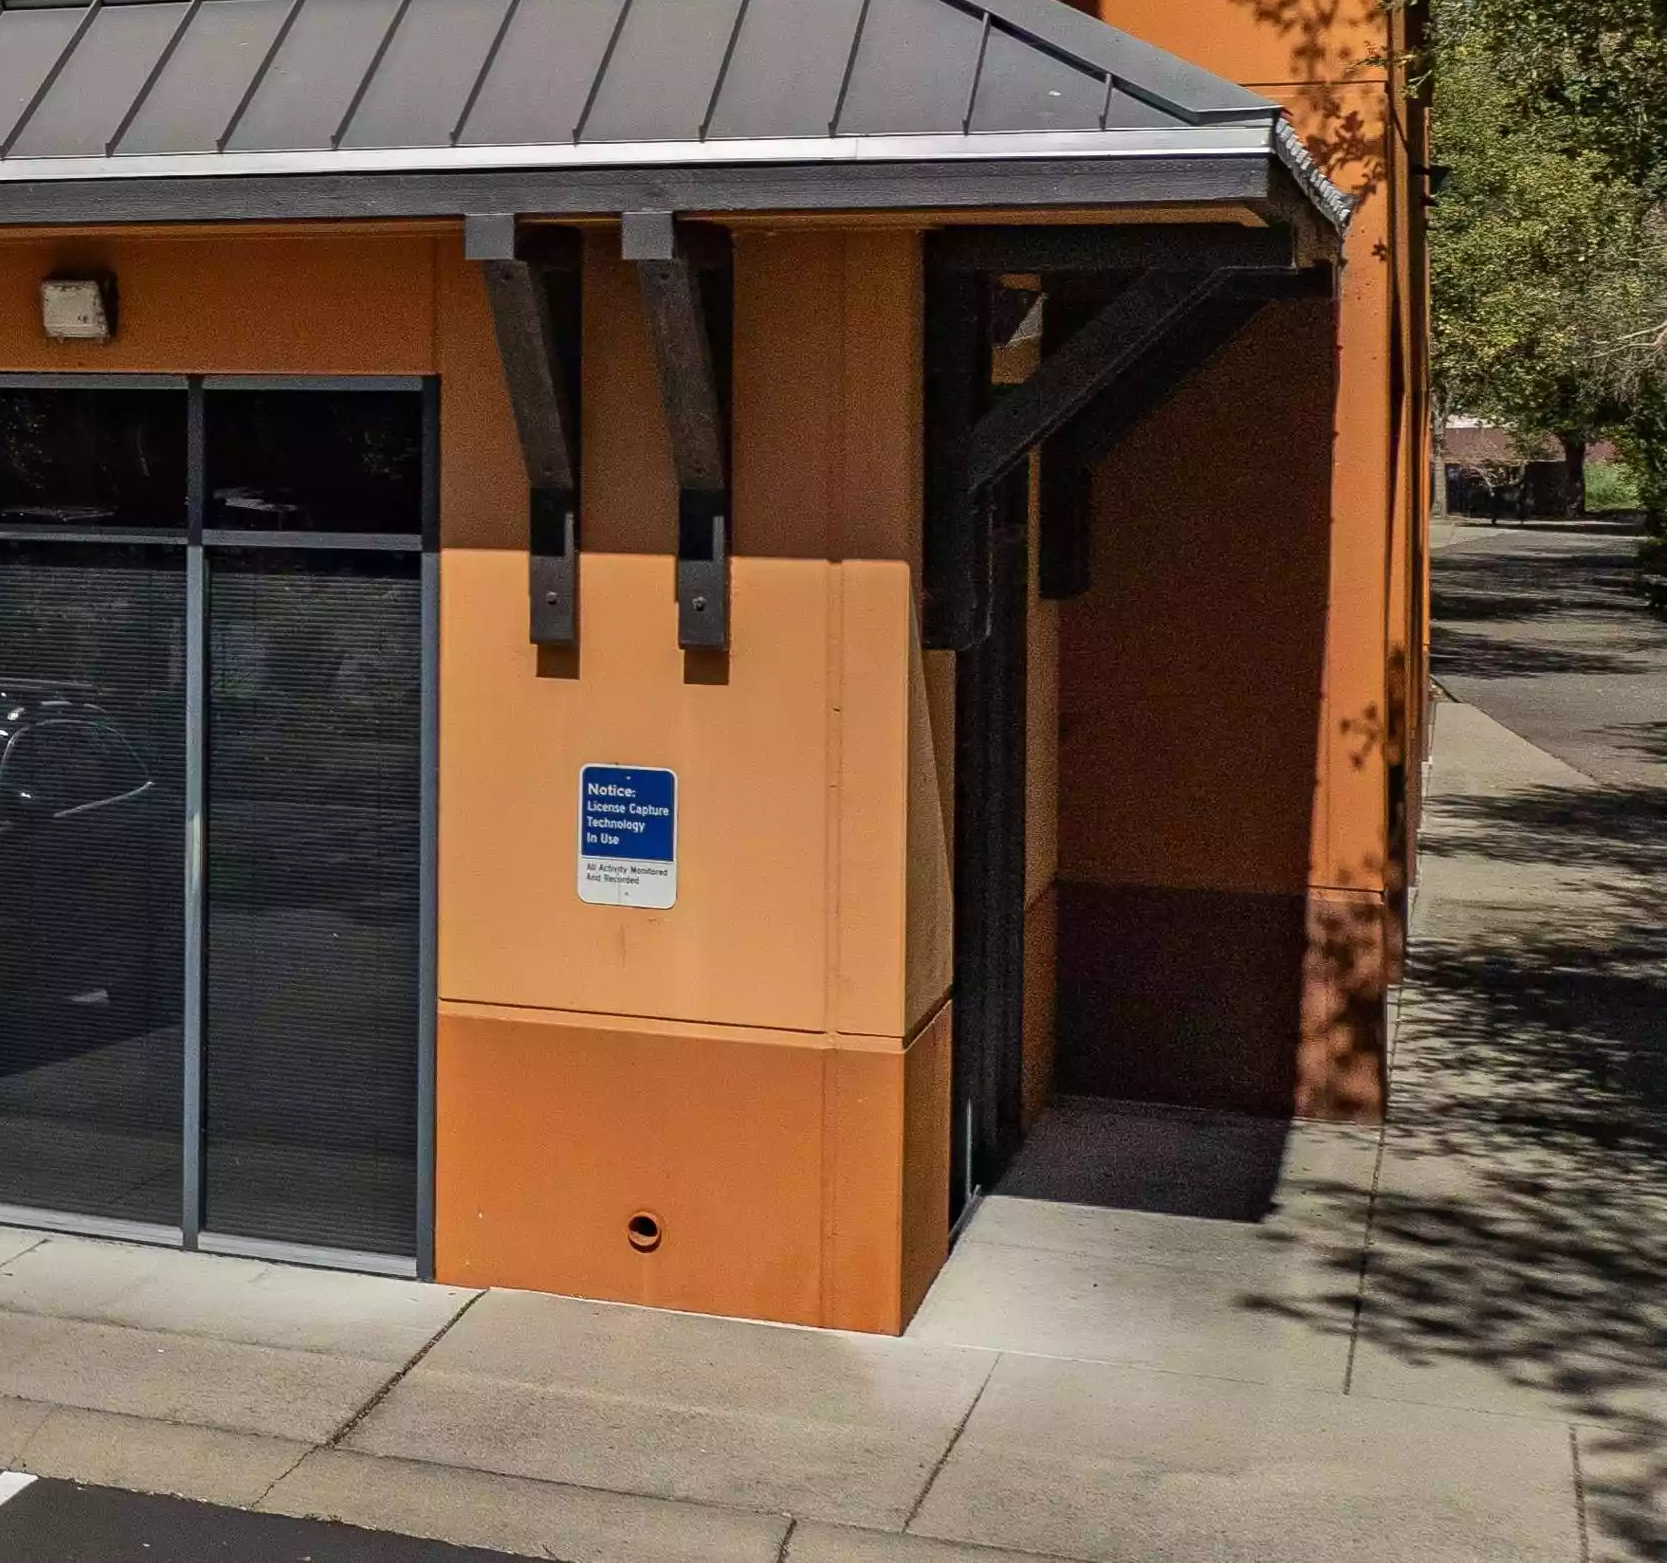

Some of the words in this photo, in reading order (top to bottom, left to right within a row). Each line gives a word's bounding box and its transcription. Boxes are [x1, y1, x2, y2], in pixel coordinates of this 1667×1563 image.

[587, 783, 636, 797] Notice:
[587, 800, 626, 814] License
[629, 804, 669, 817] Capture
[587, 816, 646, 833] Technology
[587, 832, 598, 843] In
[600, 833, 619, 845] Use
[586, 863, 596, 871] All
[599, 864, 627, 876] Activity
[631, 866, 668, 876] Monitored
[586, 874, 601, 882] And
[604, 875, 640, 885] Recorded
